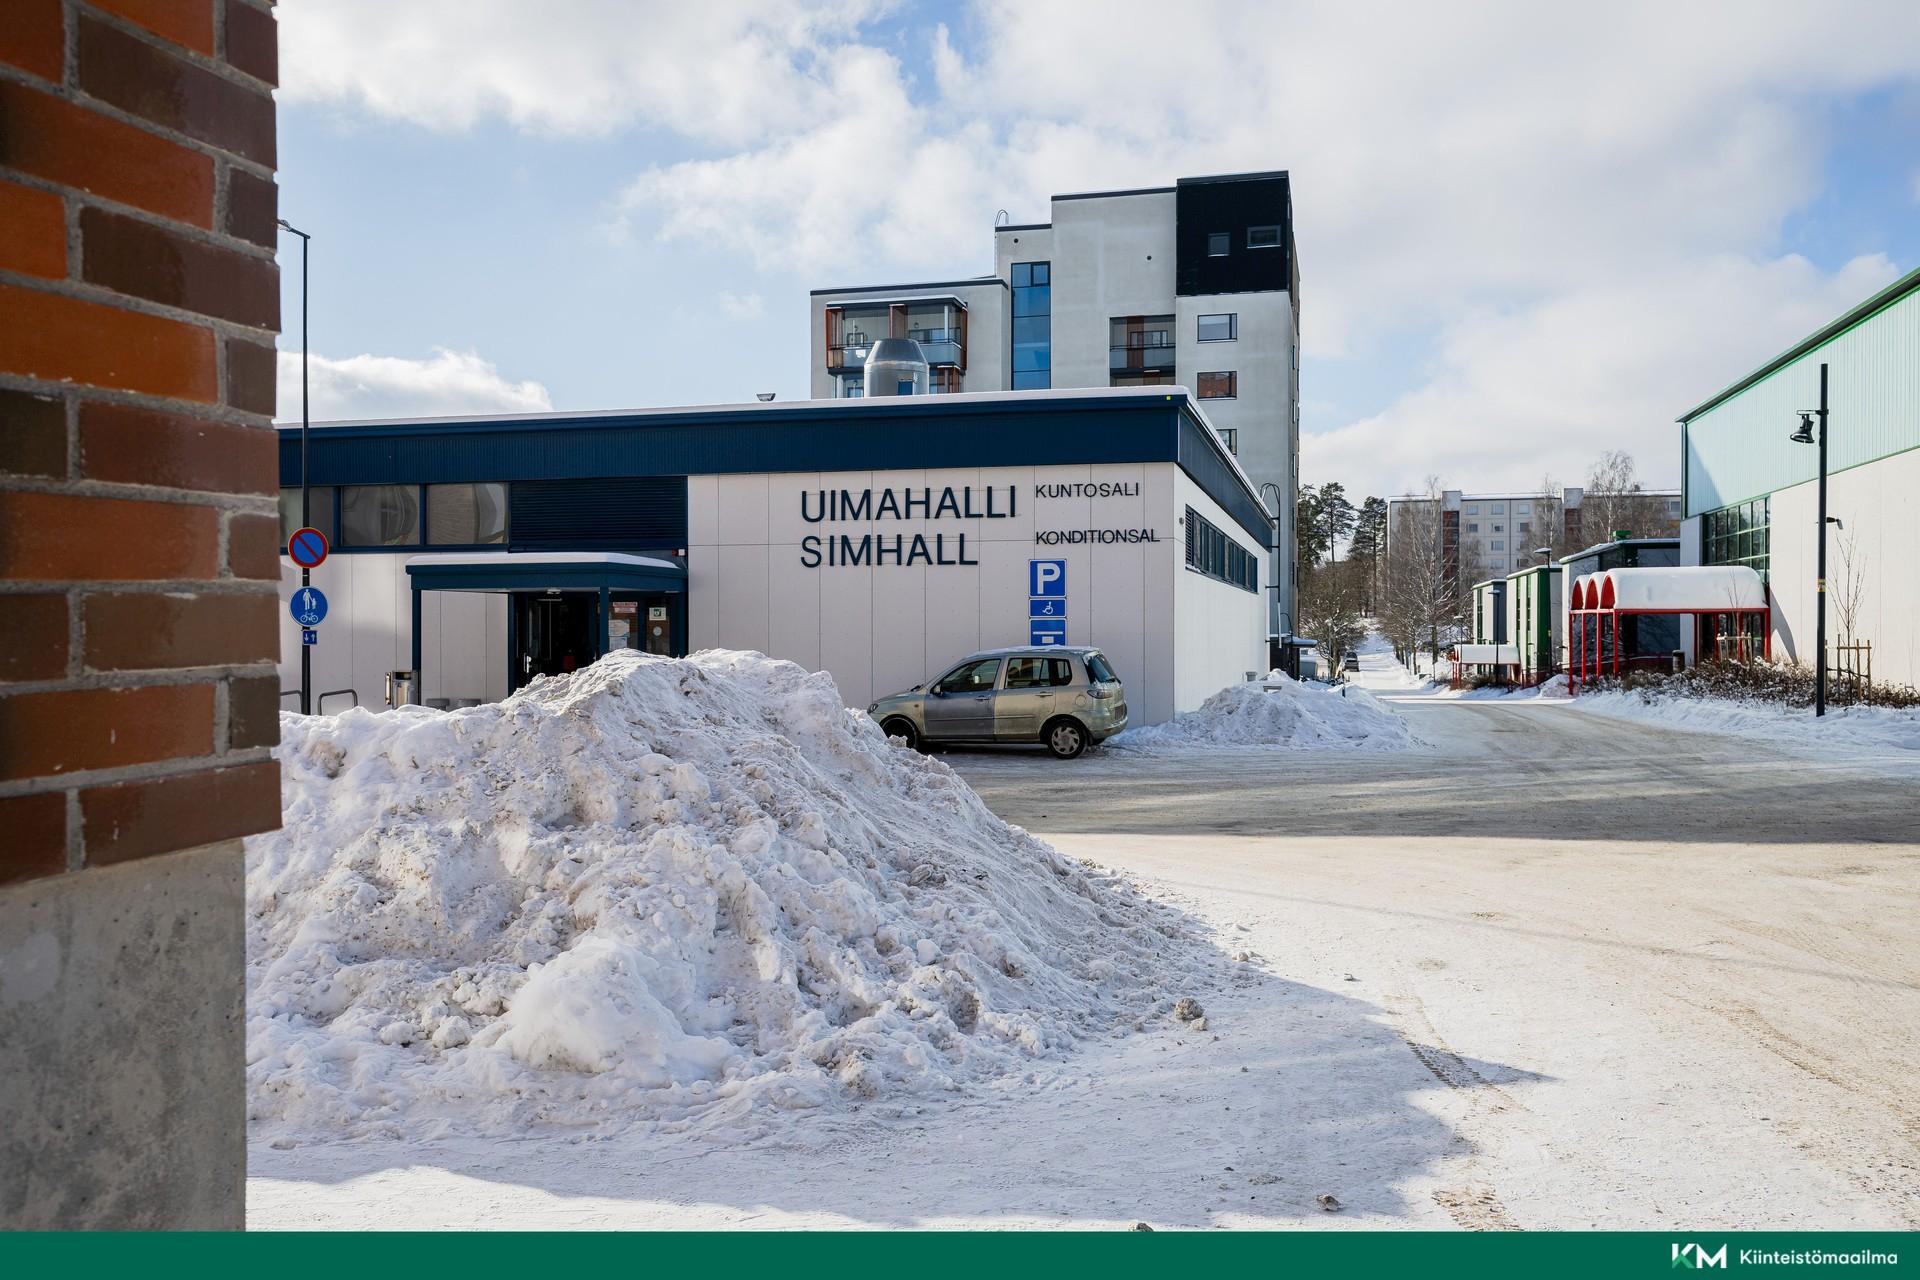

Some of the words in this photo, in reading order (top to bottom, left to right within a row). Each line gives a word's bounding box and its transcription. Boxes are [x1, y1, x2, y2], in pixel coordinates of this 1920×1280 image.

[801, 485, 1016, 522] UIMAHALLI
[1035, 482, 1139, 498] KUNTOSALI
[800, 533, 979, 568] SIMHALL
[1036, 528, 1161, 545] KONDITIONSAL
[1037, 562, 1061, 595] P
